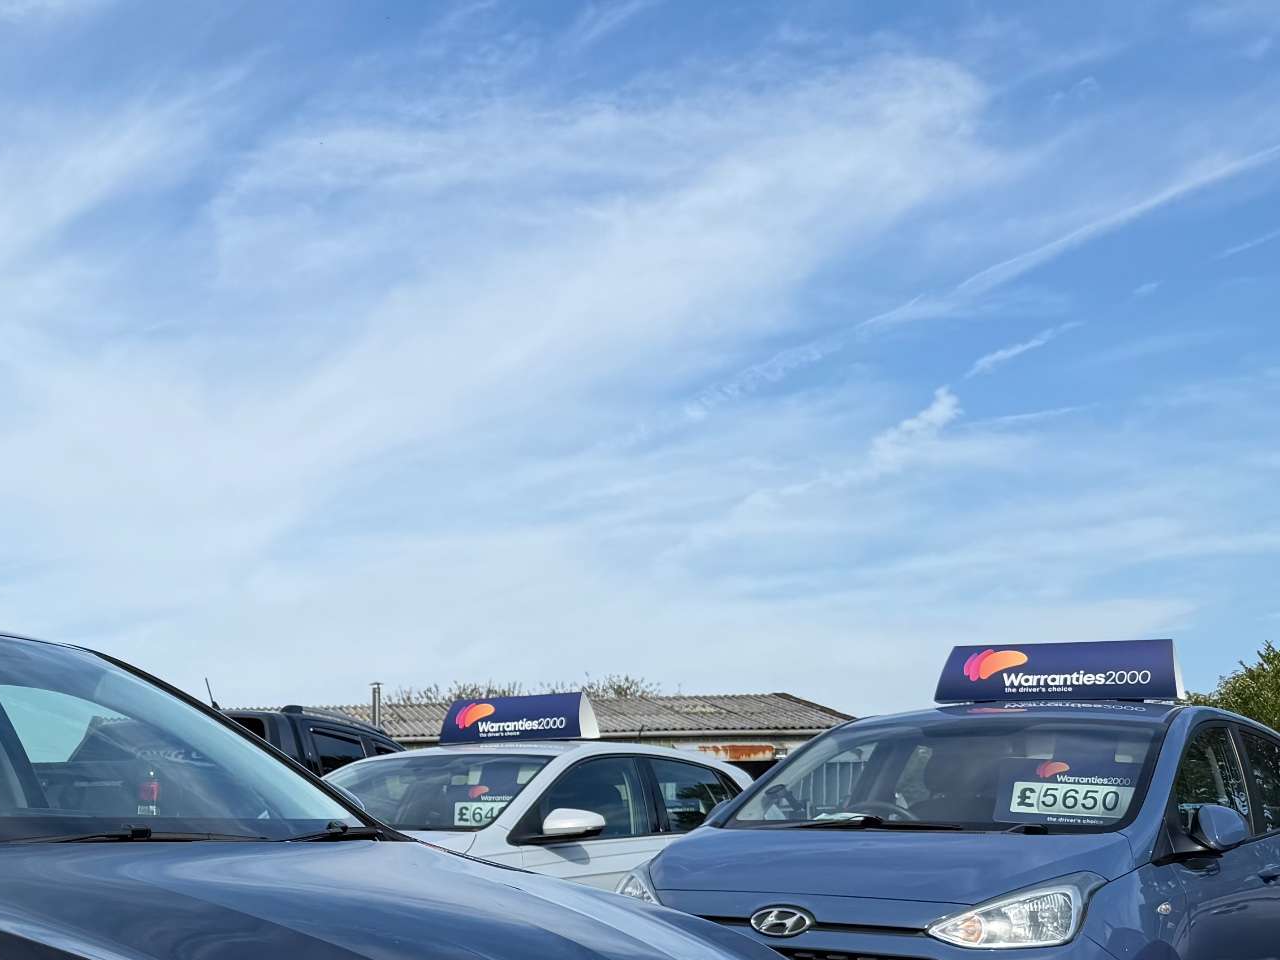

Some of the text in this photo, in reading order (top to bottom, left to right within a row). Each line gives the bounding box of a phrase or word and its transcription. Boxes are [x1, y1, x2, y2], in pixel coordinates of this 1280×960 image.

[1002, 670, 1151, 687] Warranties2000
[478, 717, 566, 733] Warranties2000
[1056, 774, 1131, 786] Warranties2000
[1015, 786, 1120, 812] £5650
